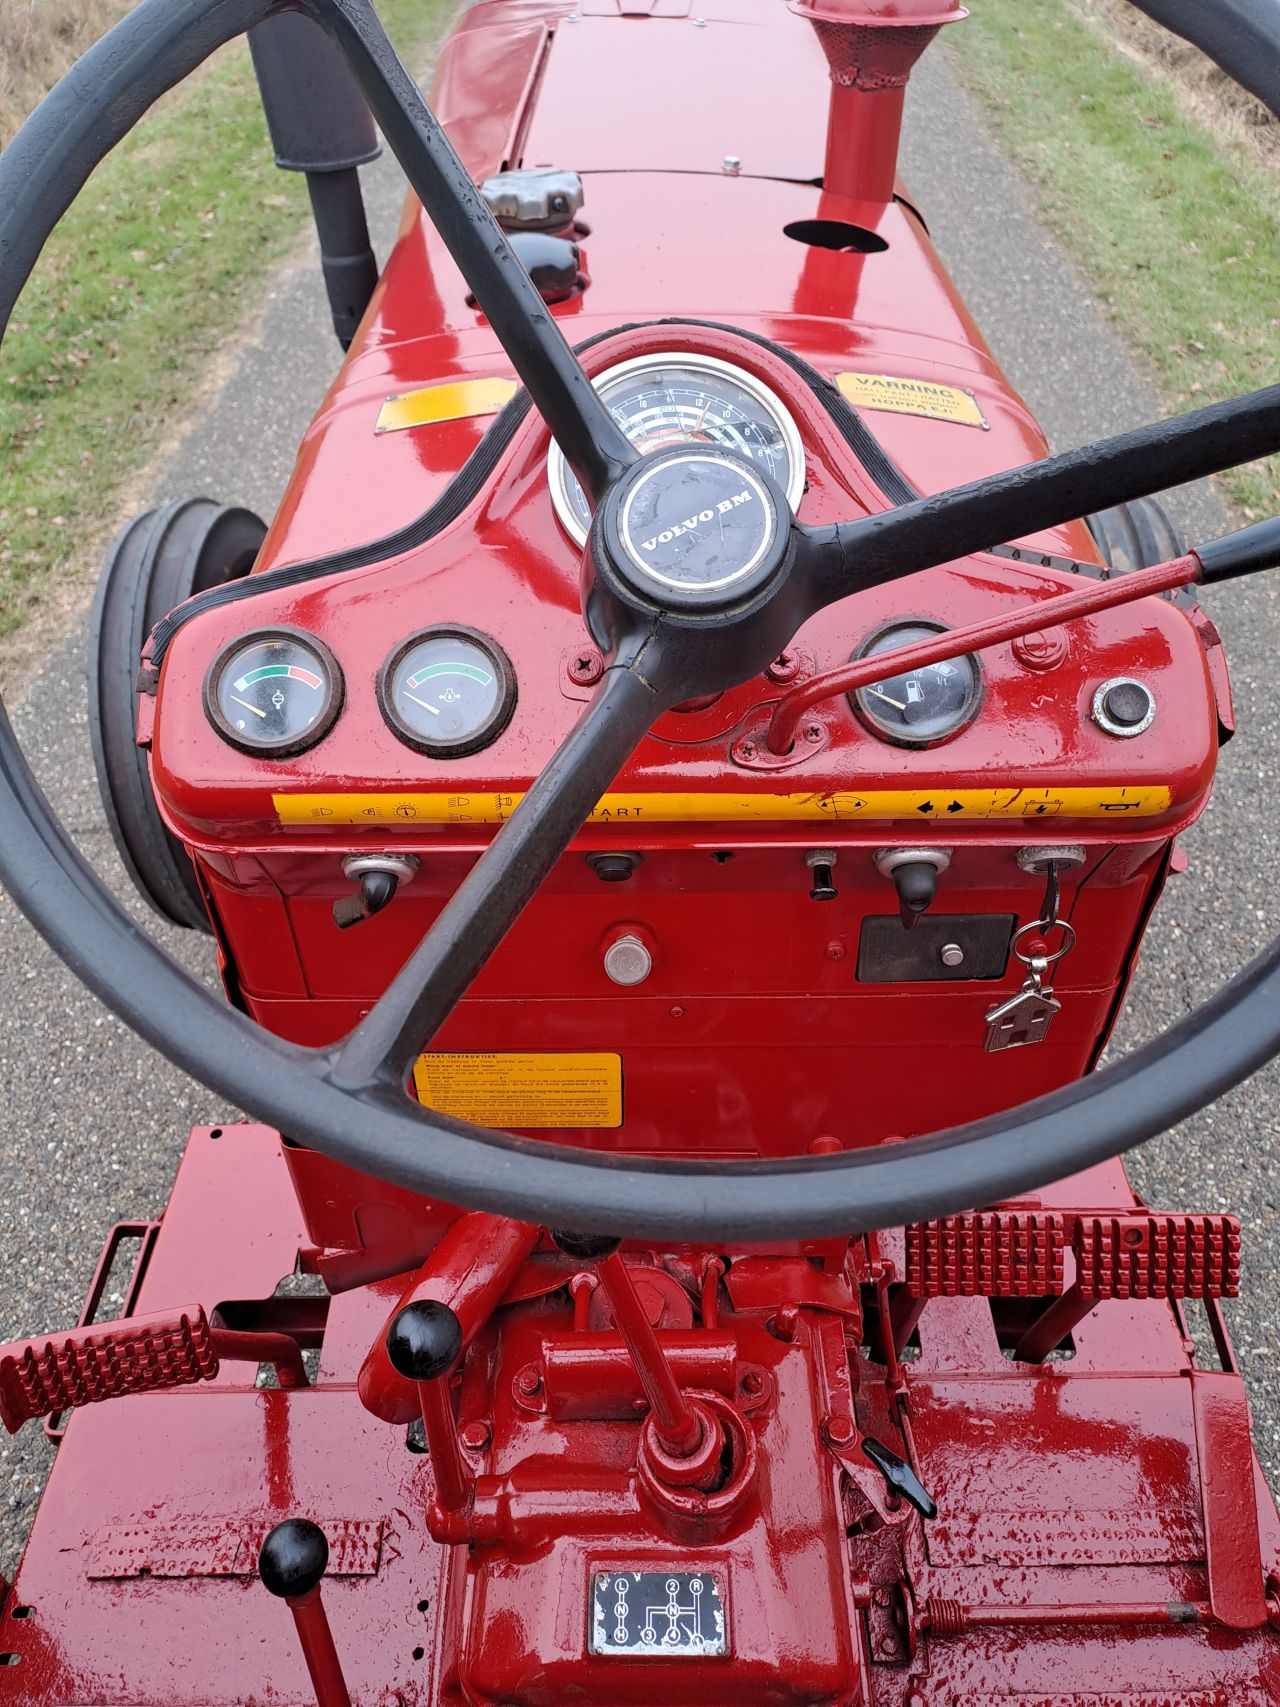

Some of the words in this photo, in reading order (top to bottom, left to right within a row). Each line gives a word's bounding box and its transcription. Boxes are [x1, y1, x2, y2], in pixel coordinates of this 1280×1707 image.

[856, 377, 954, 398] VARNING
[639, 400, 648, 408] 16
[695, 398, 704, 407] 12
[722, 410, 731, 418] 10
[744, 427, 751, 436] 8
[757, 448, 764, 457] 6
[641, 509, 714, 551] VOLVO
[716, 490, 753, 514] BM
[591, 807, 643, 816] TART
